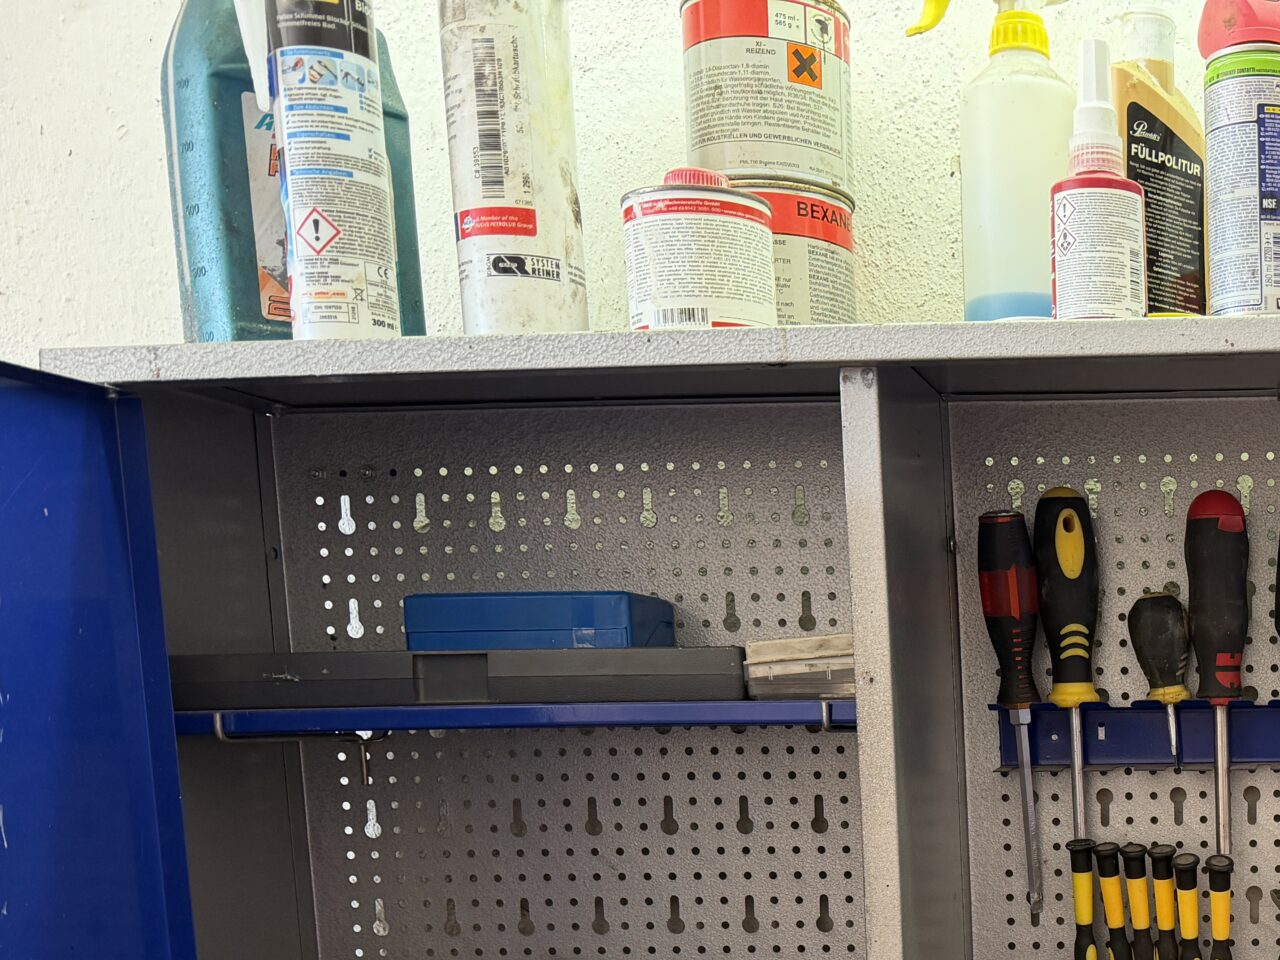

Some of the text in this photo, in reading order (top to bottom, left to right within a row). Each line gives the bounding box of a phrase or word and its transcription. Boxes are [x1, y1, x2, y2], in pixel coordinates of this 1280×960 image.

[774, 12, 787, 20] 475
[745, 47, 776, 56] REIZEND
[763, 133, 813, 146] GEWERBLICHEN
[1131, 143, 1201, 177] FÜLLPOLITUR
[531, 258, 560, 271] SYSTEM
[532, 269, 560, 279] REINER
[371, 318, 386, 329] 300
